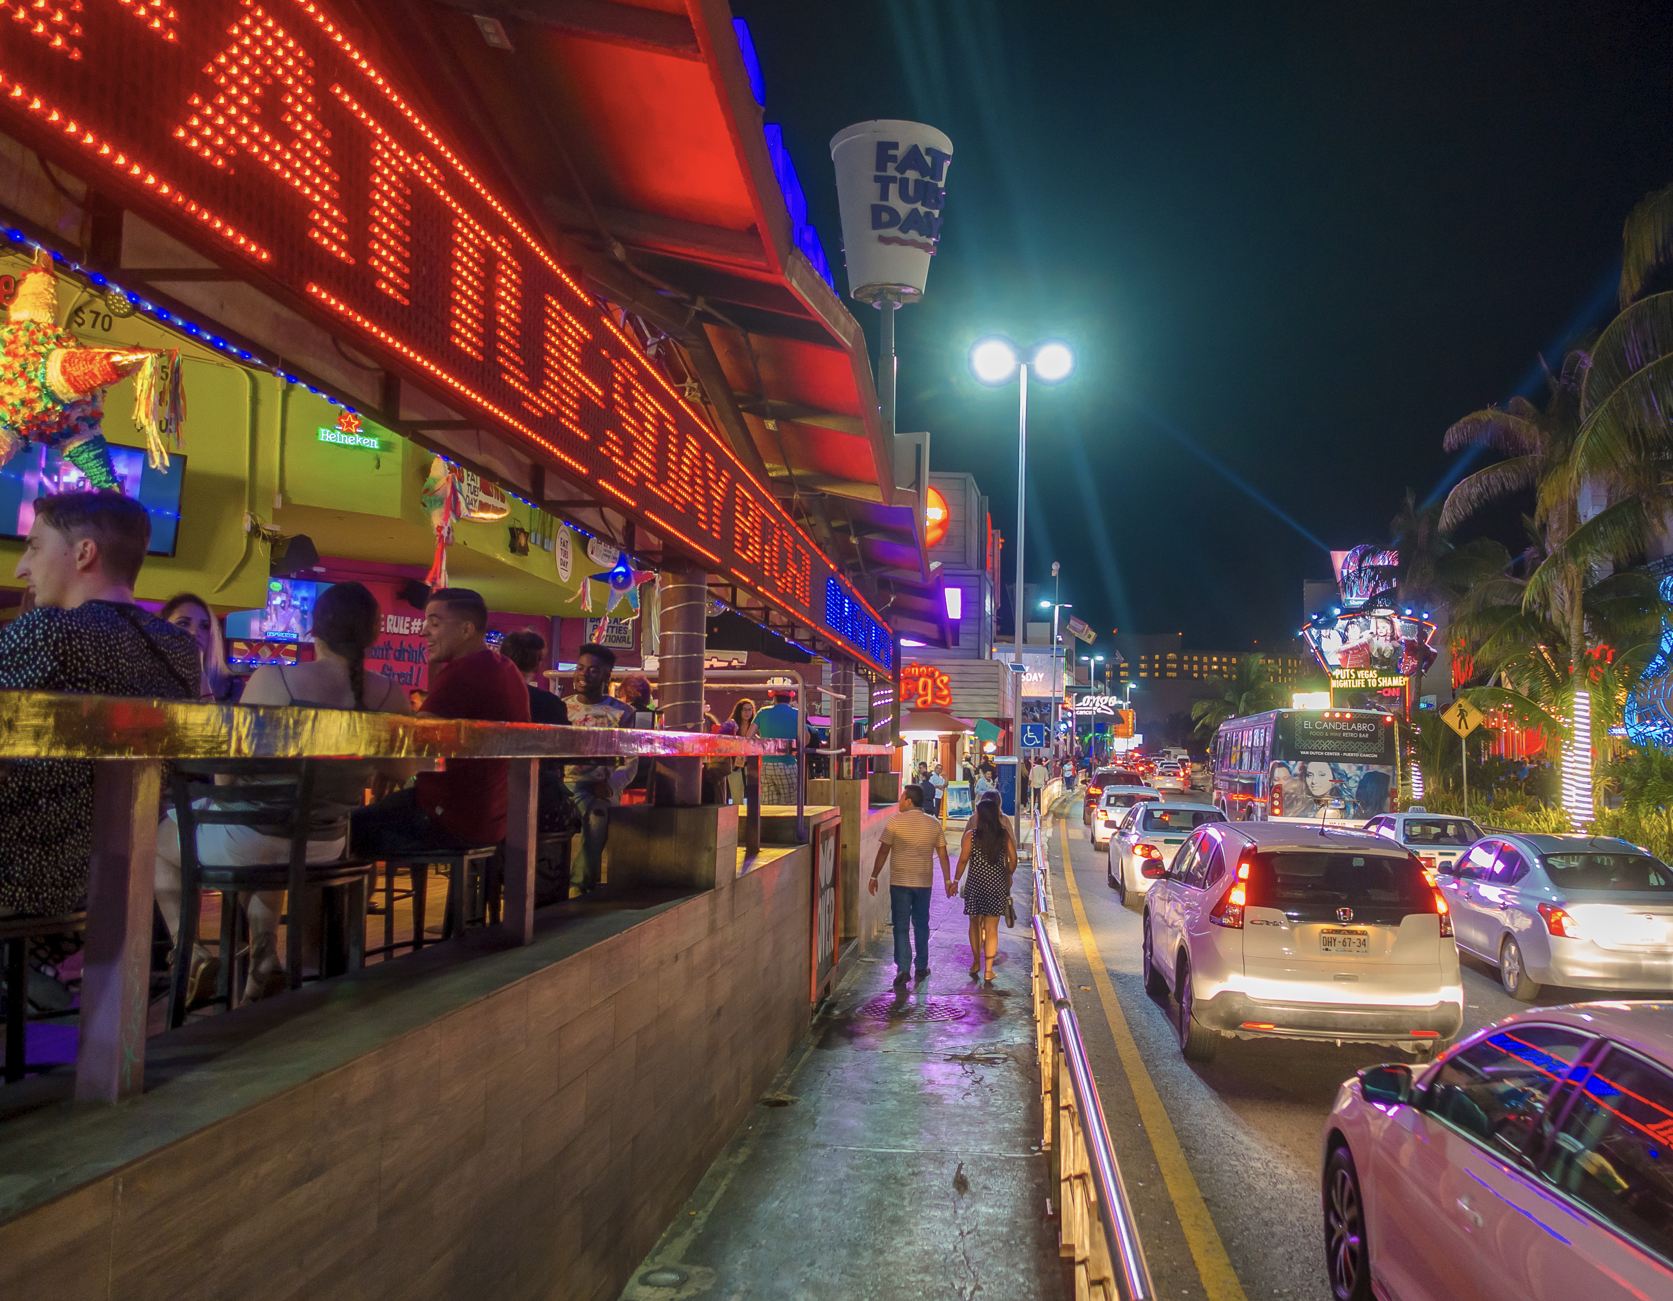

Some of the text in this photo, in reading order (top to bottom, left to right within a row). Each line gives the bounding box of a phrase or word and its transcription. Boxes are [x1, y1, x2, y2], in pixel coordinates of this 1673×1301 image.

[874, 140, 952, 182] FAT
[73, 306, 113, 332] $70
[319, 427, 379, 449] Heineken
[386, 614, 411, 635] RULE
[394, 641, 428, 665] drink
[1331, 678, 1366, 688] NIGHTLIFE
[1367, 678, 1377, 688] TO
[1356, 669, 1378, 679] VEGAS
[1303, 720, 1376, 732] EL CANDELABRO
